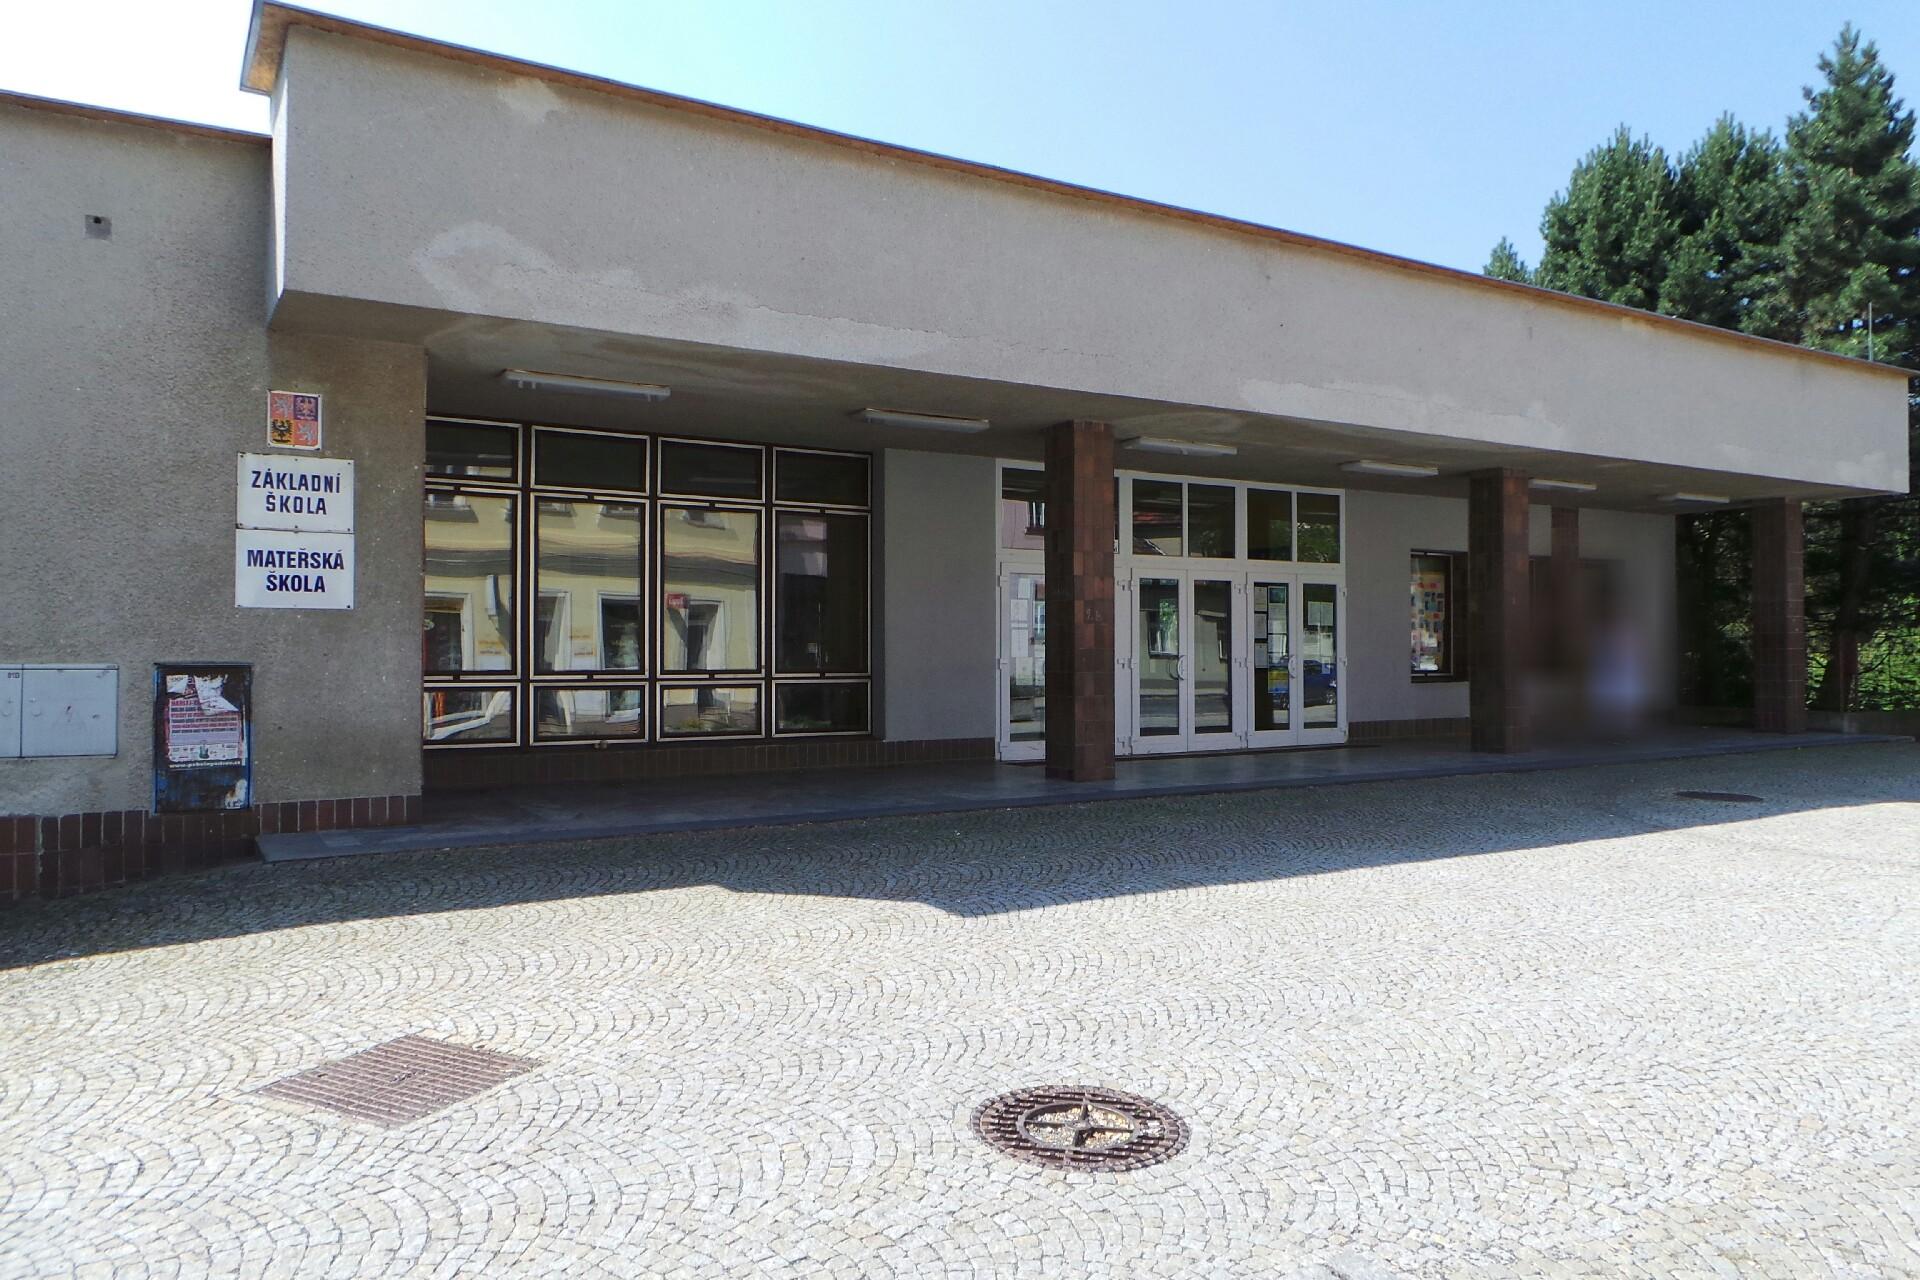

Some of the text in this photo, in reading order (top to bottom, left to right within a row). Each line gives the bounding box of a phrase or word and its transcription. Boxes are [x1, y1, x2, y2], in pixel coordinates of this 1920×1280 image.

[251, 468, 341, 494] ZÁKLADNÍ
[266, 491, 327, 515] ŠKOLA
[247, 548, 345, 570] MATEŘSKÁ
[266, 571, 326, 593] ŠKOLA
